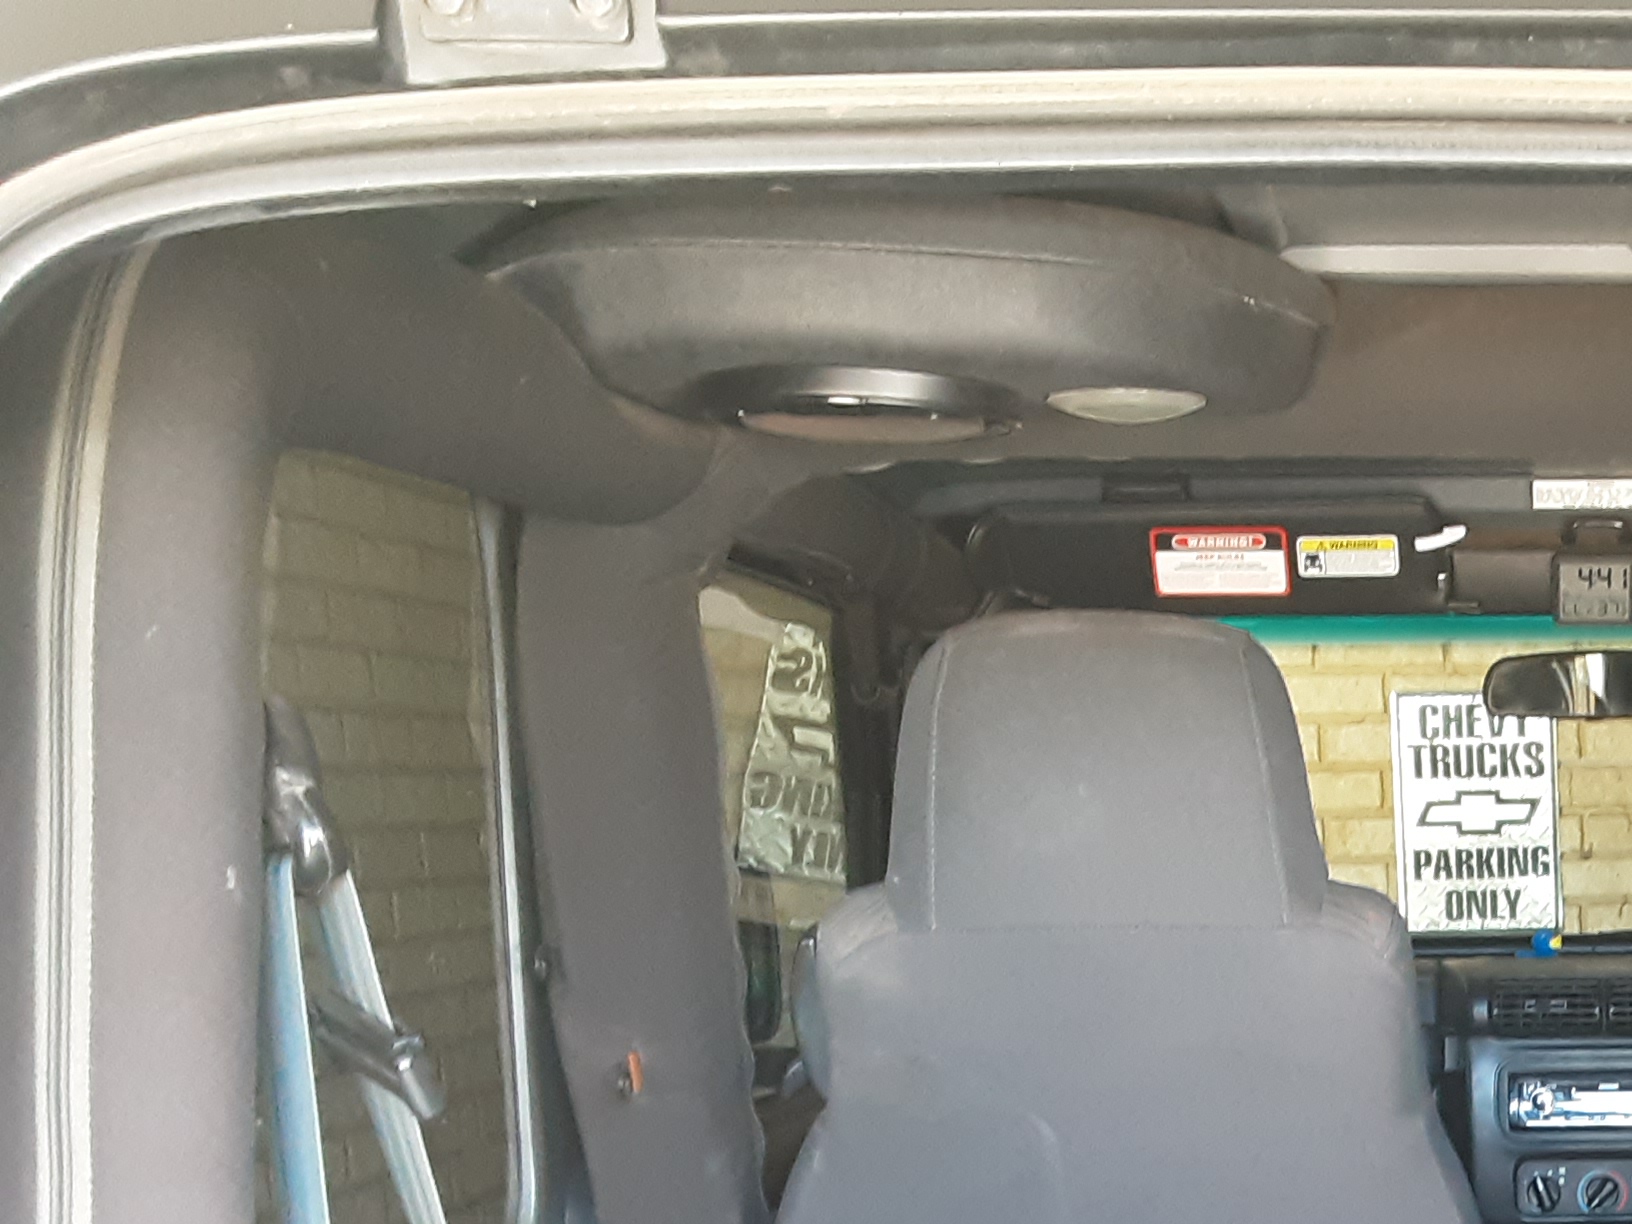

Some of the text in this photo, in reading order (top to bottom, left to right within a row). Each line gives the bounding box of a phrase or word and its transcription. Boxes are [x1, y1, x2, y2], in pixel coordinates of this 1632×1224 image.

[1408, 741, 1545, 779] TRUCKS
[1413, 845, 1550, 880] PARKING
[1445, 889, 1521, 921] ONLY
